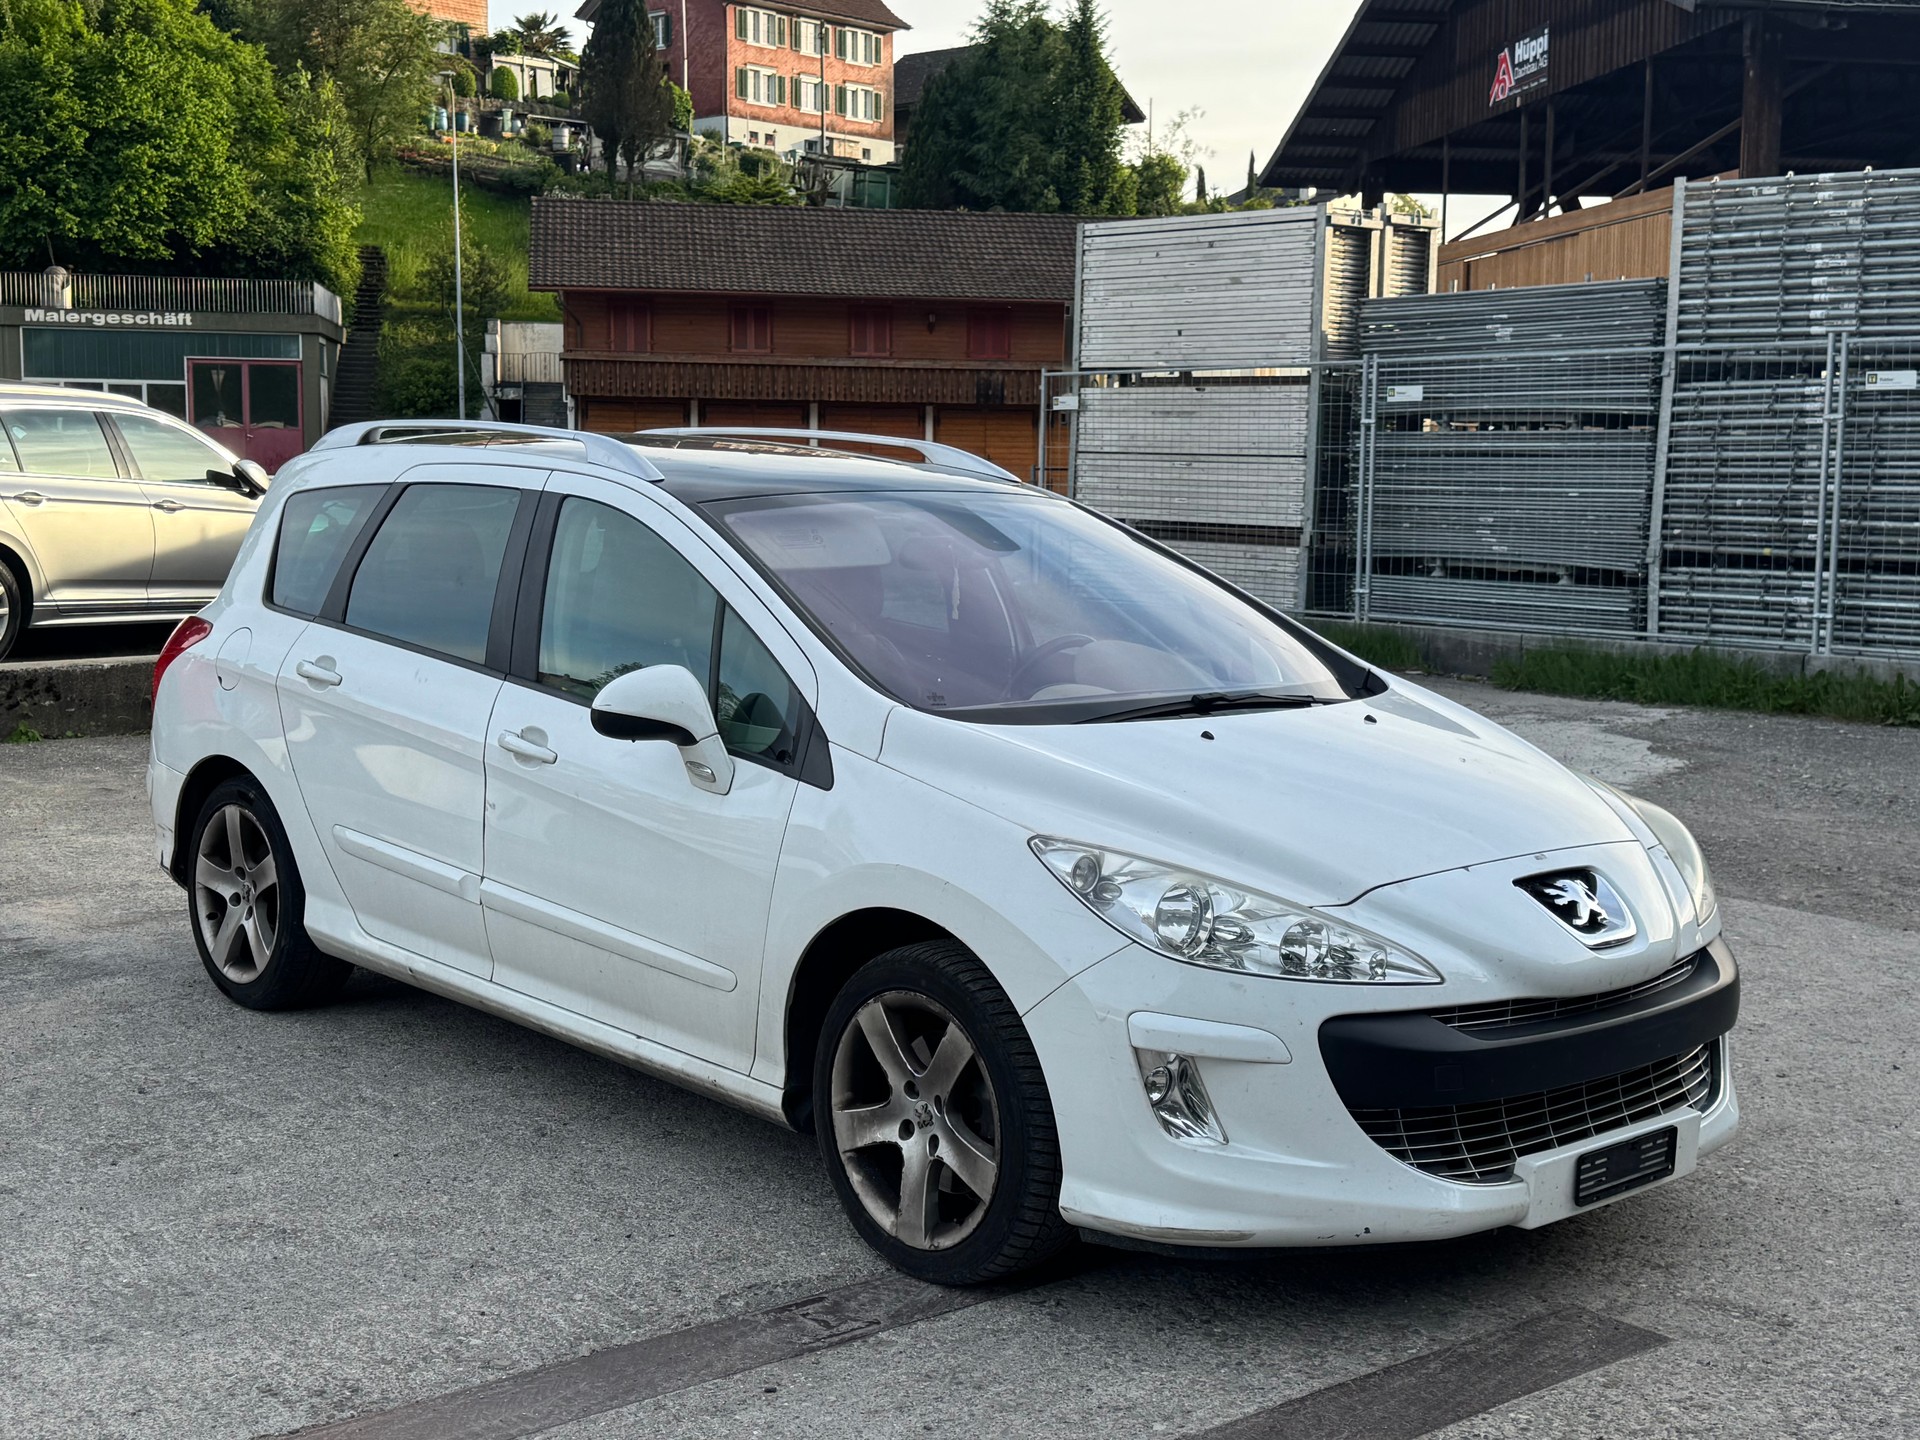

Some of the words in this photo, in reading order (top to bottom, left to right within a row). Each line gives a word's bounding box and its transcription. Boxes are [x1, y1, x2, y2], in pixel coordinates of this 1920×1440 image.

[1515, 28, 1549, 64] Hüppi
[1514, 61, 1537, 79] Dachbau
[1538, 55, 1548, 69] AG
[24, 308, 193, 326] Malergeschäft
